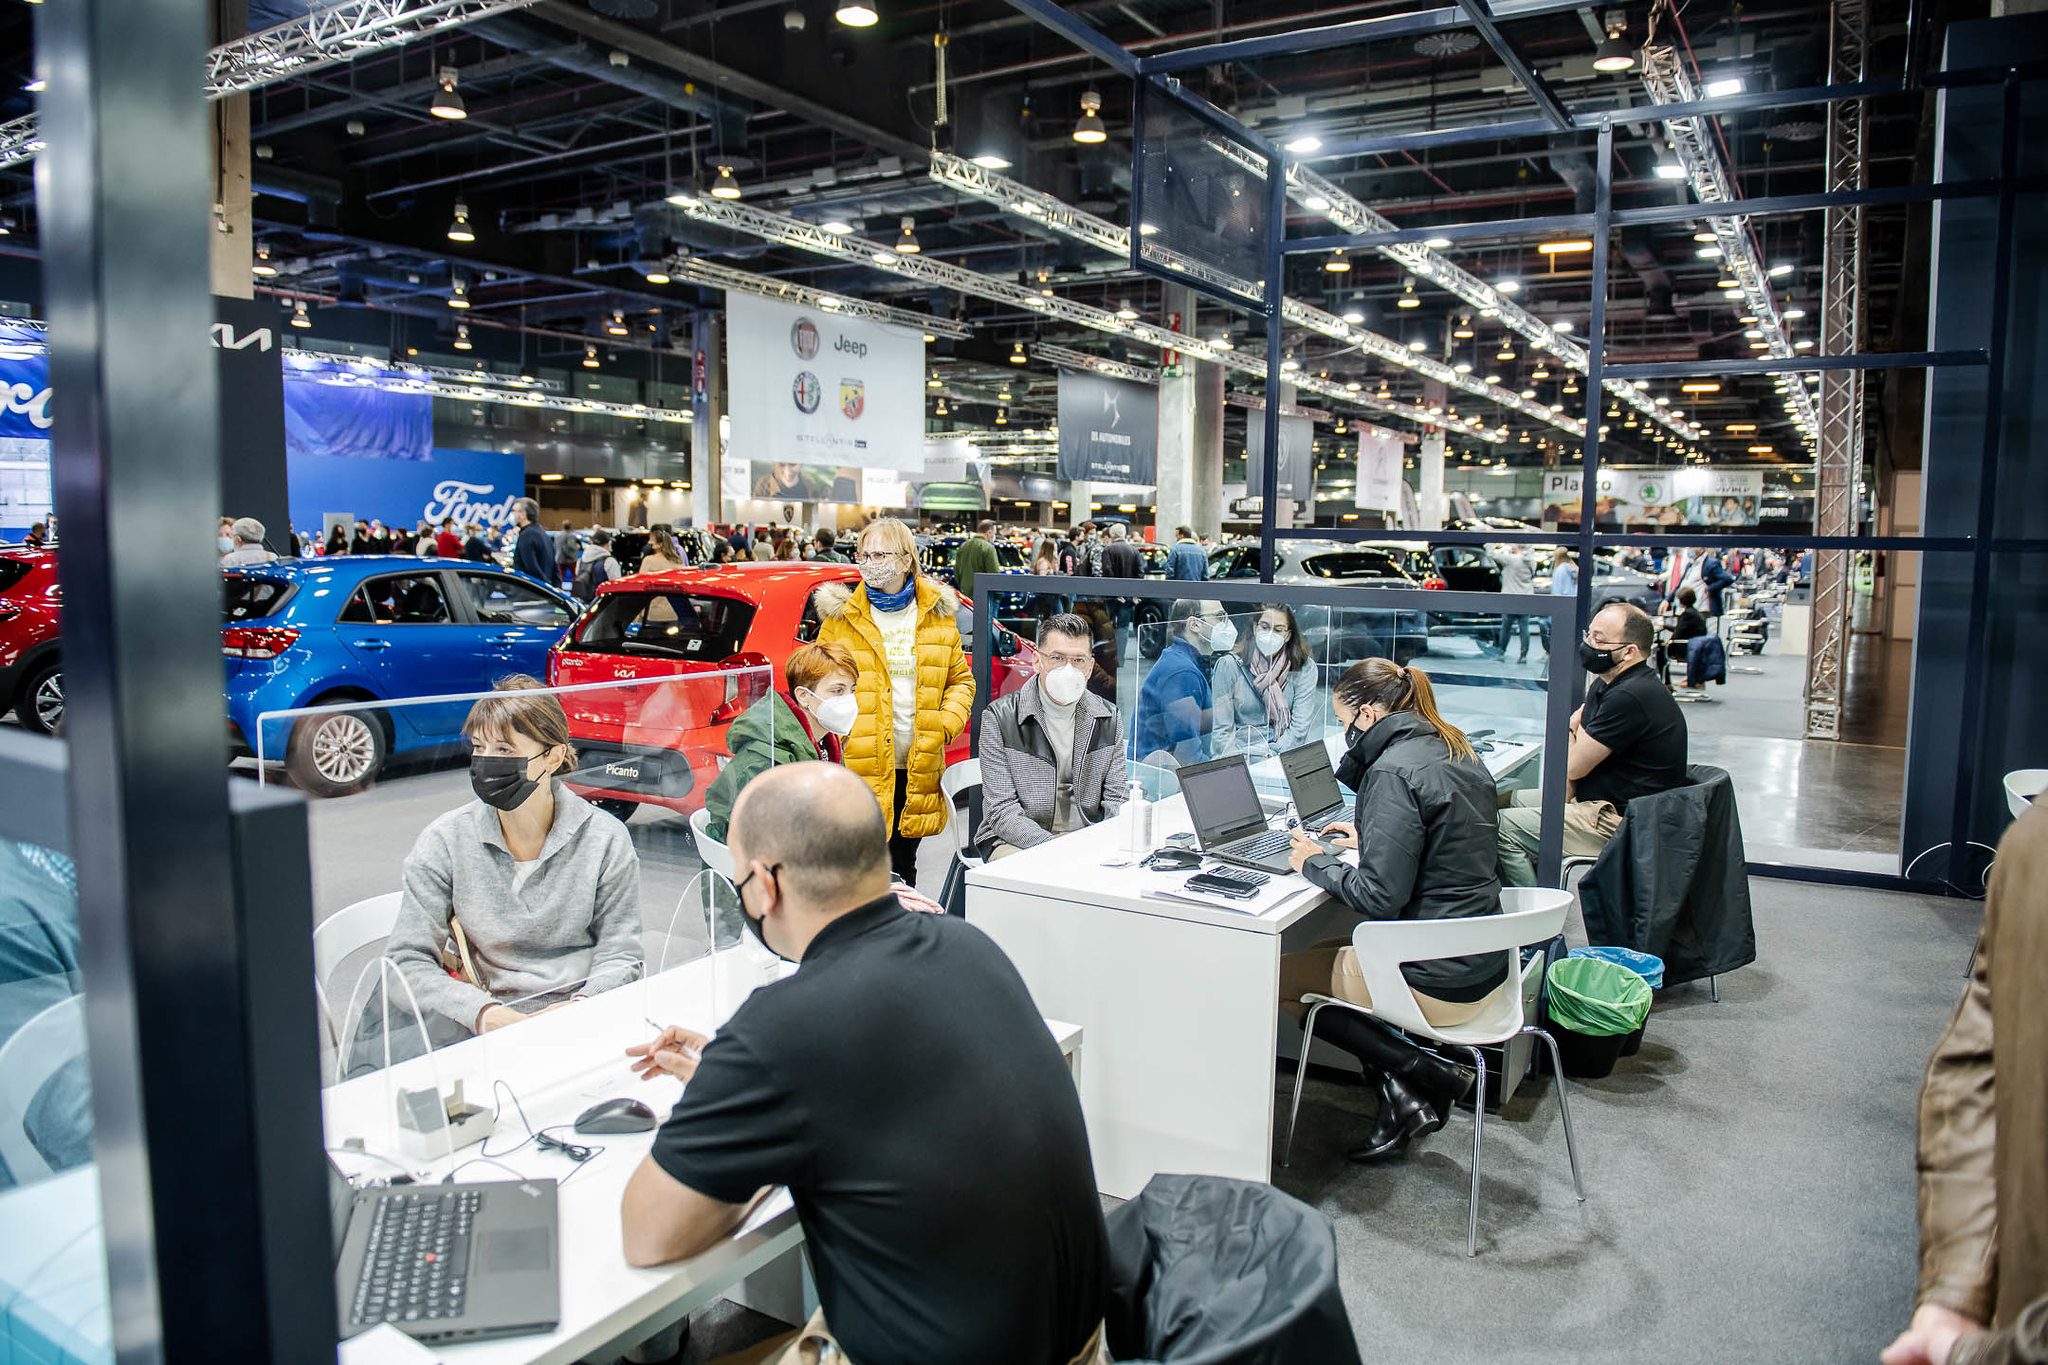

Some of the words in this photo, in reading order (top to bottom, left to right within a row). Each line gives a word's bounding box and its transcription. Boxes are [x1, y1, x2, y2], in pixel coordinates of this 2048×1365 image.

[834, 333, 868, 359] Jeep
[1551, 475, 1612, 492] Plao
[424, 480, 516, 527] Ford
[614, 669, 636, 678] KIA
[605, 763, 639, 778] Picanto
